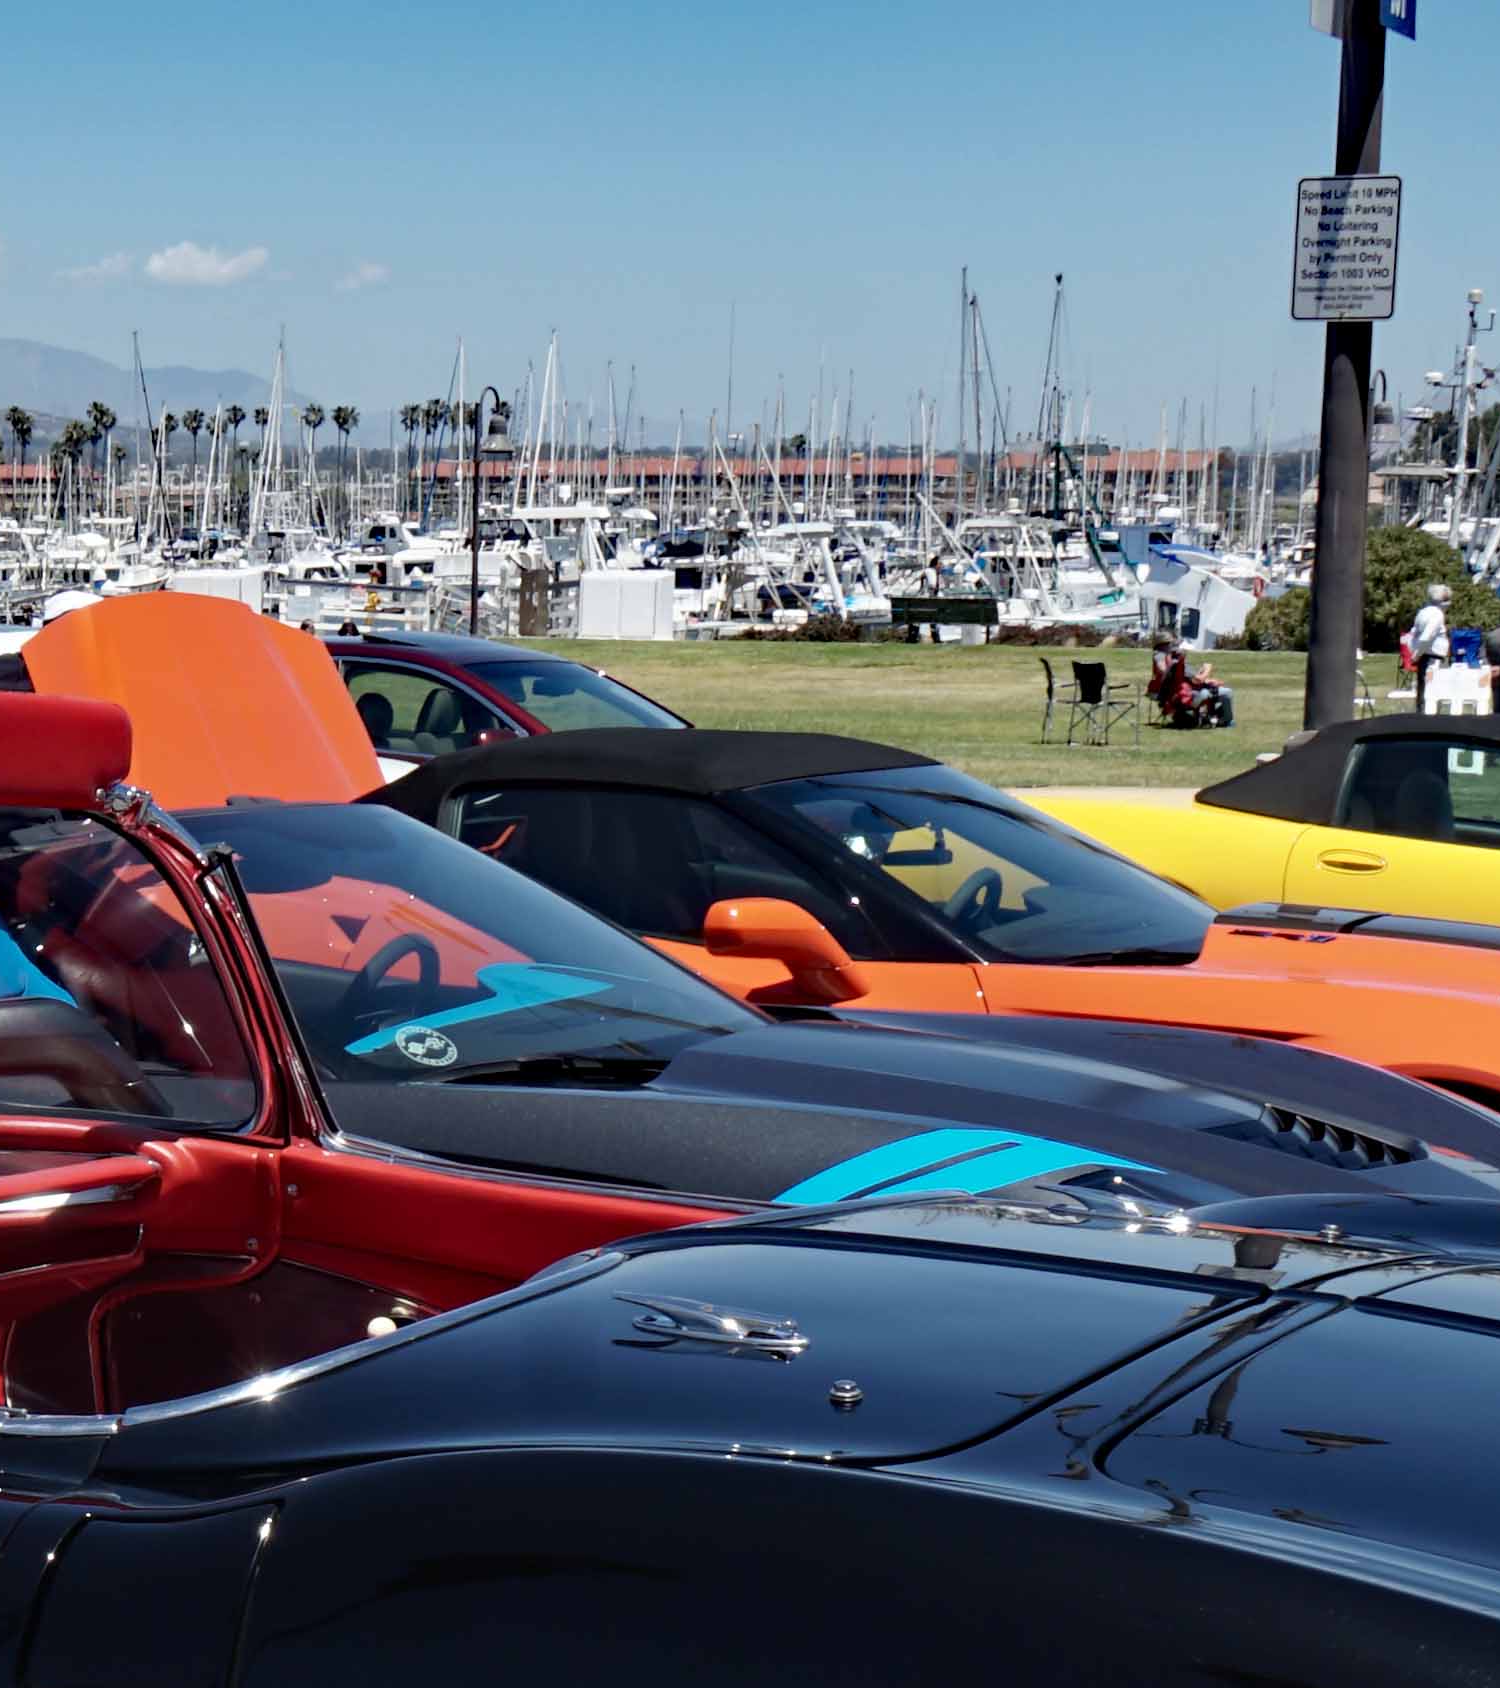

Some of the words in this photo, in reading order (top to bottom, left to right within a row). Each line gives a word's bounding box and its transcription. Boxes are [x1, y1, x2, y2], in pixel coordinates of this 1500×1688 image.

[1301, 190, 1331, 201] Speed
[1375, 188, 1398, 198] MPH
[1304, 207, 1318, 216] No
[1321, 205, 1352, 216] Beach
[1355, 204, 1393, 217] Parking
[1318, 222, 1331, 232] No
[1334, 220, 1379, 233] Loitering
[1302, 237, 1351, 249] Overnight
[1354, 236, 1392, 249] Parking
[1309, 254, 1321, 266] by
[1324, 253, 1356, 263] Permit
[1359, 252, 1383, 265] Only
[1301, 269, 1338, 280] Section
